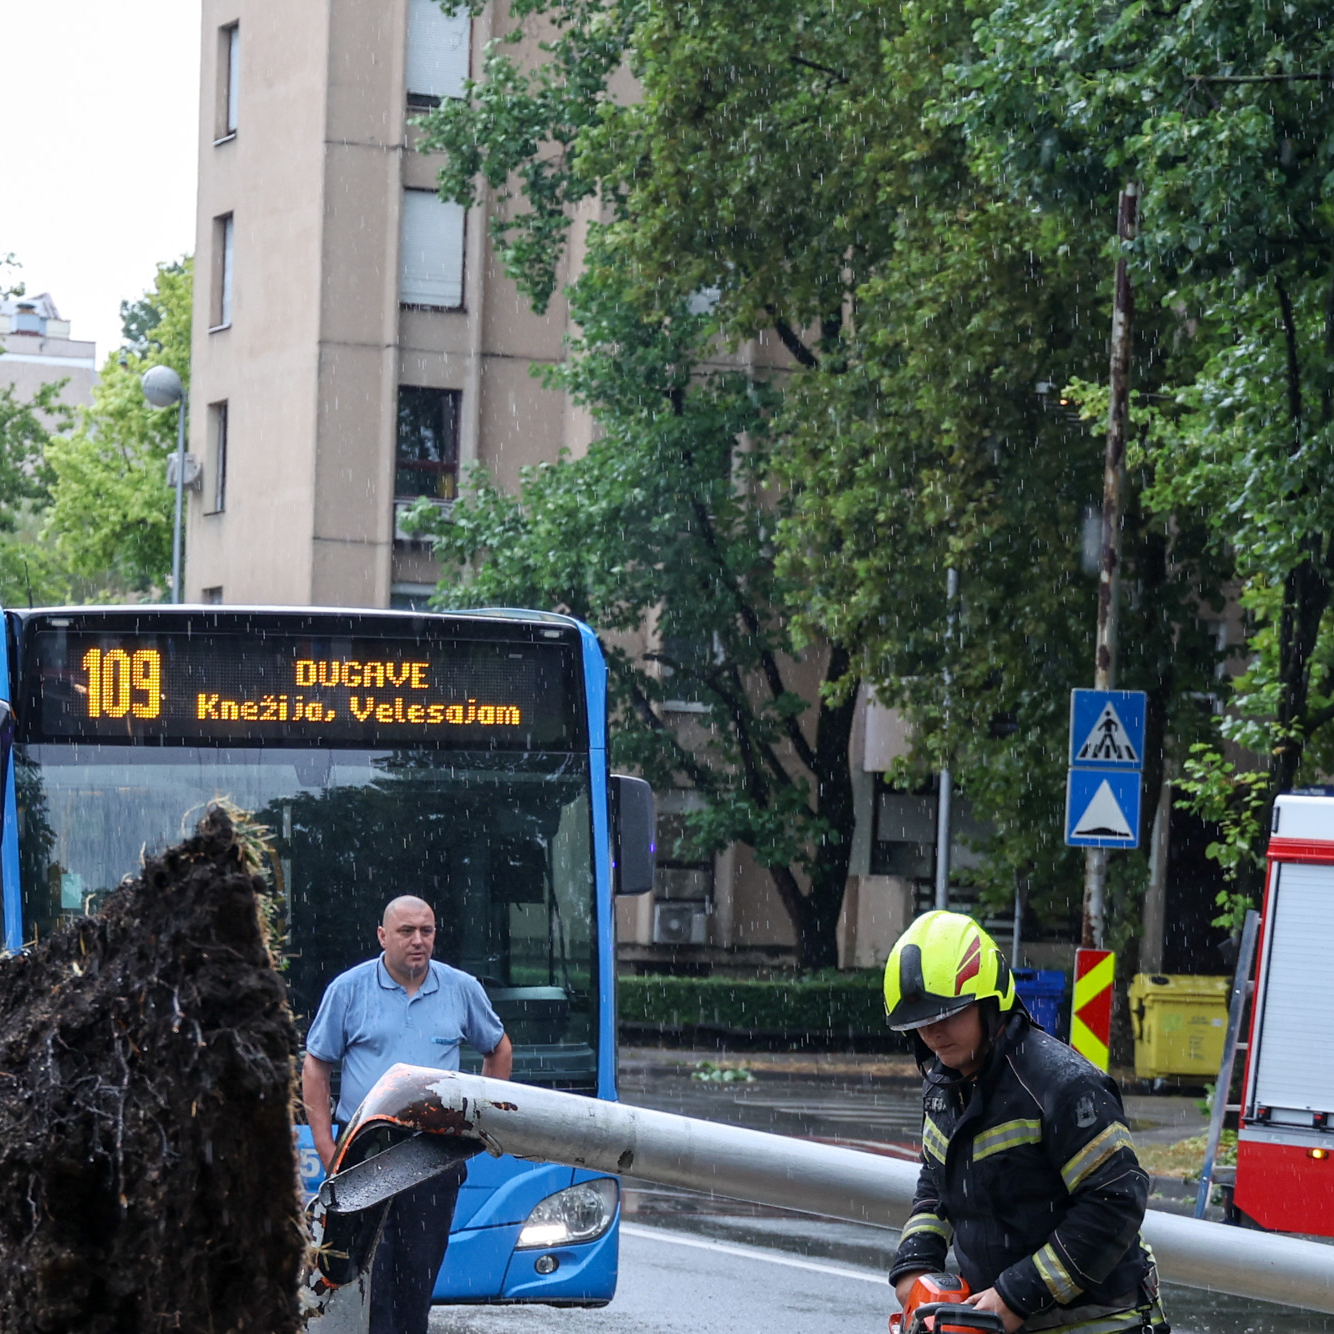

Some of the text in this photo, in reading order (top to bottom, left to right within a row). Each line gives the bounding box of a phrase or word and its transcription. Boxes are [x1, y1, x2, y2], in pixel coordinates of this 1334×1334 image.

[82, 647, 161, 719] 109
[295, 659, 430, 689] DUGAVE
[196, 693, 521, 725] Knežija, Velesajam
